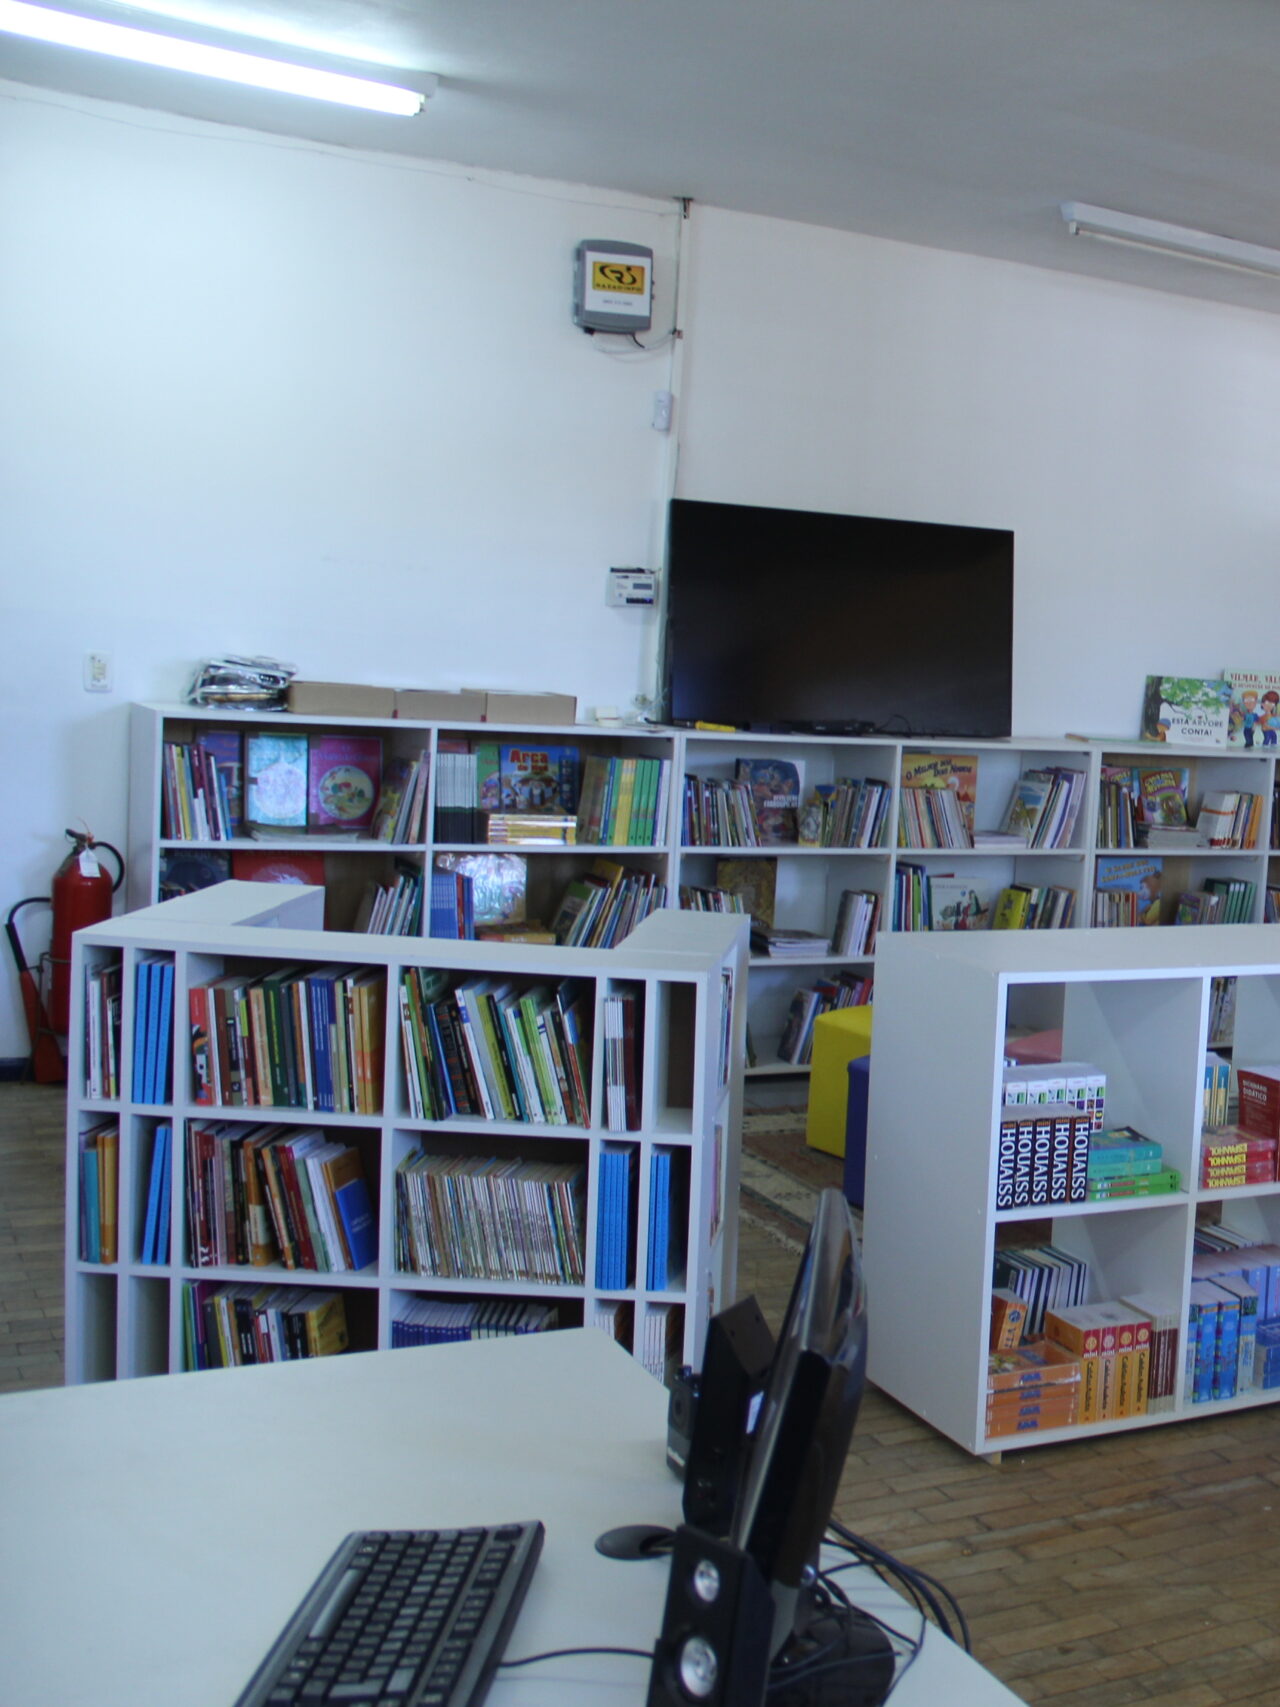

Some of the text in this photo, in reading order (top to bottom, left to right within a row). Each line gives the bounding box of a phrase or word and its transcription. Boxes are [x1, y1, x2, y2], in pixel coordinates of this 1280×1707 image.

[998, 1128, 1016, 1207] HOUAISS
[1014, 1126, 1033, 1204] HOUAISS
[1032, 1125, 1050, 1203] HOUAISS
[1051, 1123, 1070, 1200] HOUAISS
[1071, 1122, 1089, 1200] HOUAISS
[1209, 1153, 1246, 1167] ESPANHOL
